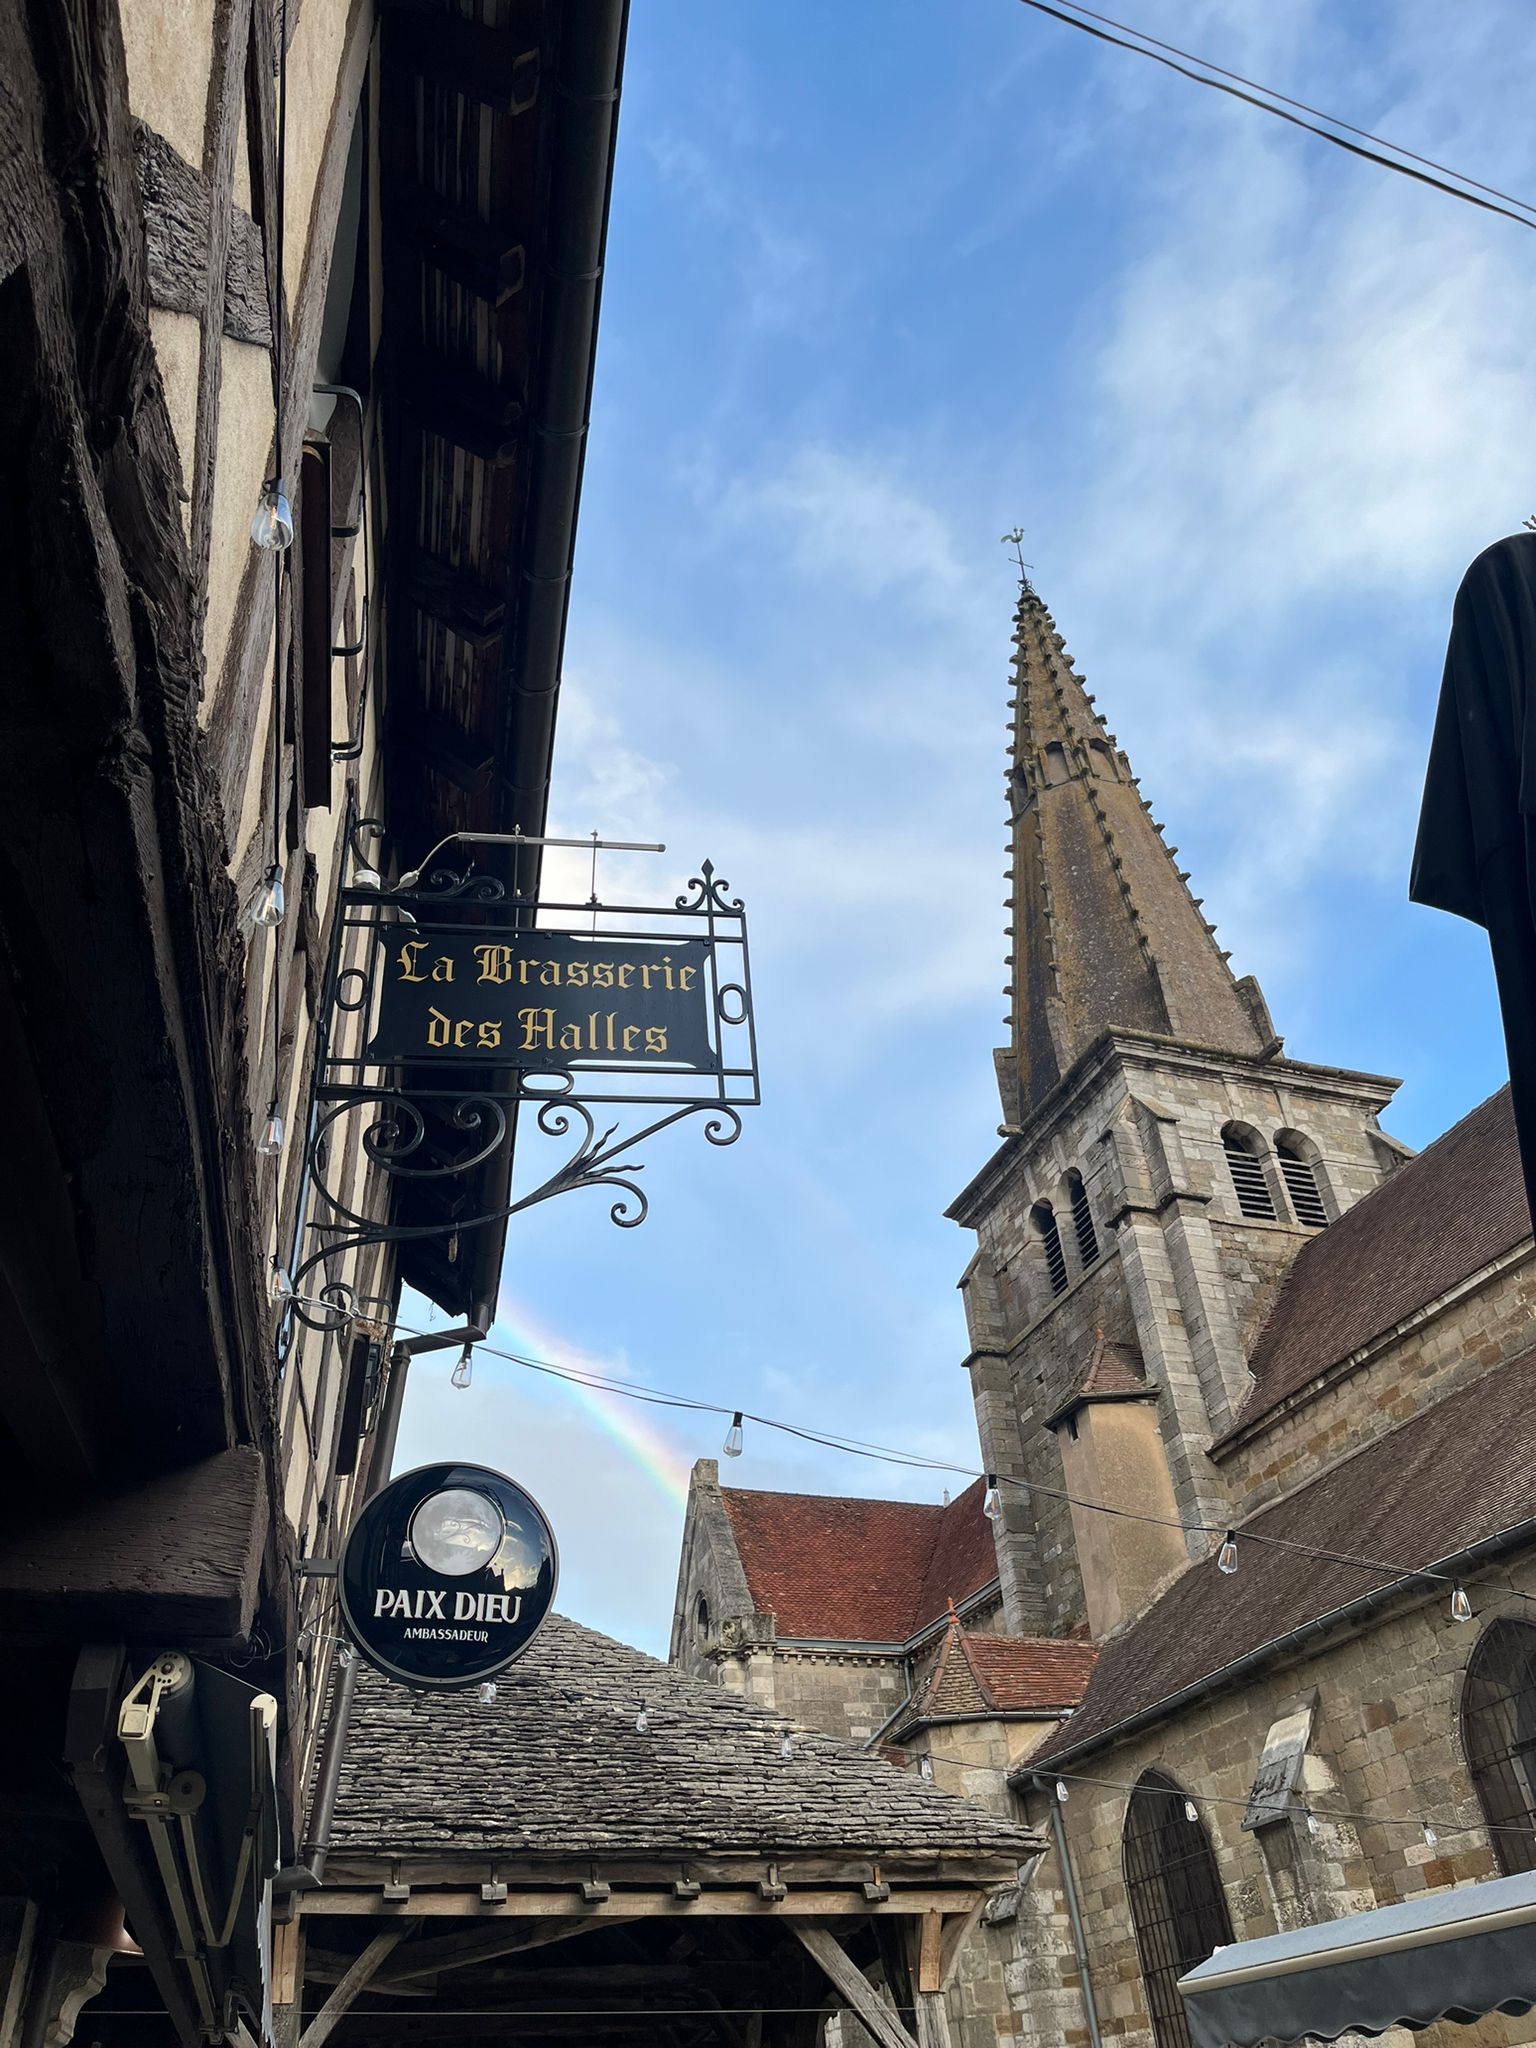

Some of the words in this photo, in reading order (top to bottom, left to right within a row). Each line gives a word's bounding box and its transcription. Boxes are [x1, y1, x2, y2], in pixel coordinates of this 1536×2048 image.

[396, 940, 455, 984] La
[473, 944, 697, 992] Brasserie
[426, 1006, 503, 1049] des
[517, 1007, 669, 1053] Halles
[373, 1589, 447, 1620] PAIX
[453, 1591, 522, 1624] DIEU
[404, 1627, 489, 1643] AMBASSADEUR
